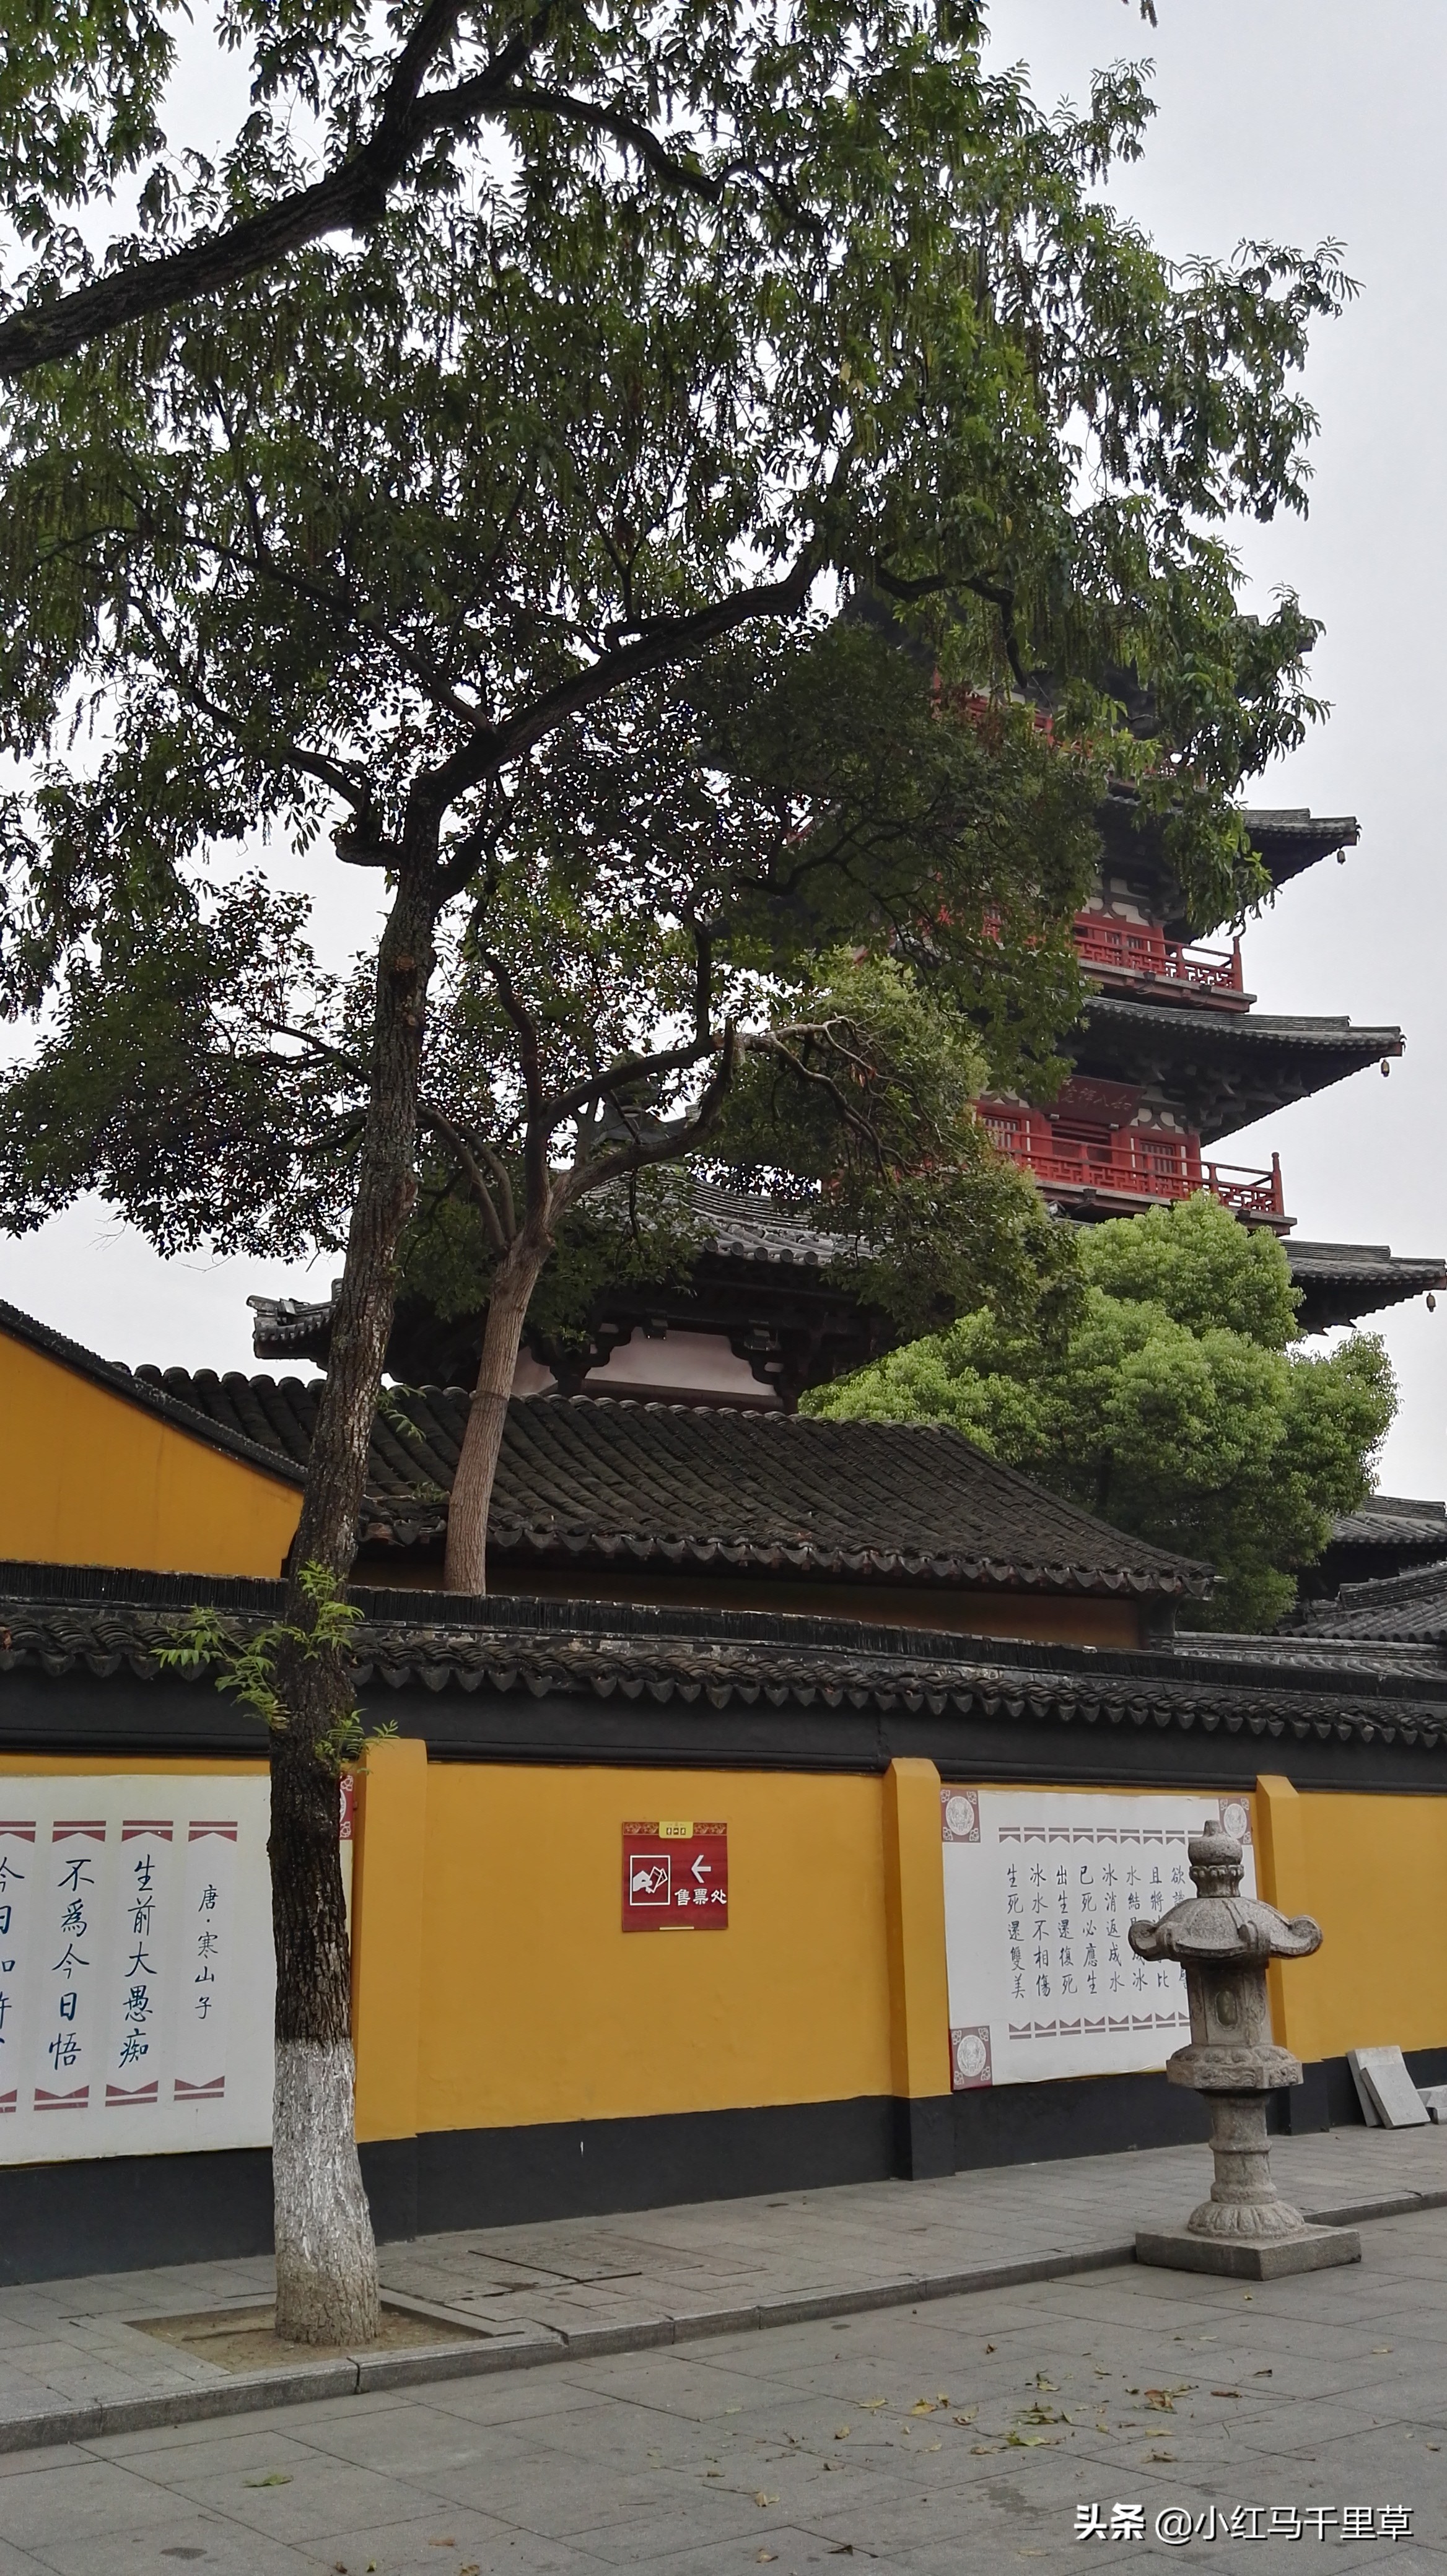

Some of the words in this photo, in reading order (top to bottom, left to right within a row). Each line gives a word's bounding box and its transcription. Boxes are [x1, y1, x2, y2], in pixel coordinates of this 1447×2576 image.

[118, 1854, 157, 2069] 生前大愚痴
[675, 1889, 727, 1906] 售票处
[1007, 1863, 1026, 1999] 生死還雙美
[1030, 1863, 1051, 1997] 冰水不相傷
[1056, 1865, 1078, 1995] 出生還復死
[1103, 1863, 1125, 1992] 冰消返成水
[1150, 1866, 1169, 1988] 且將比
